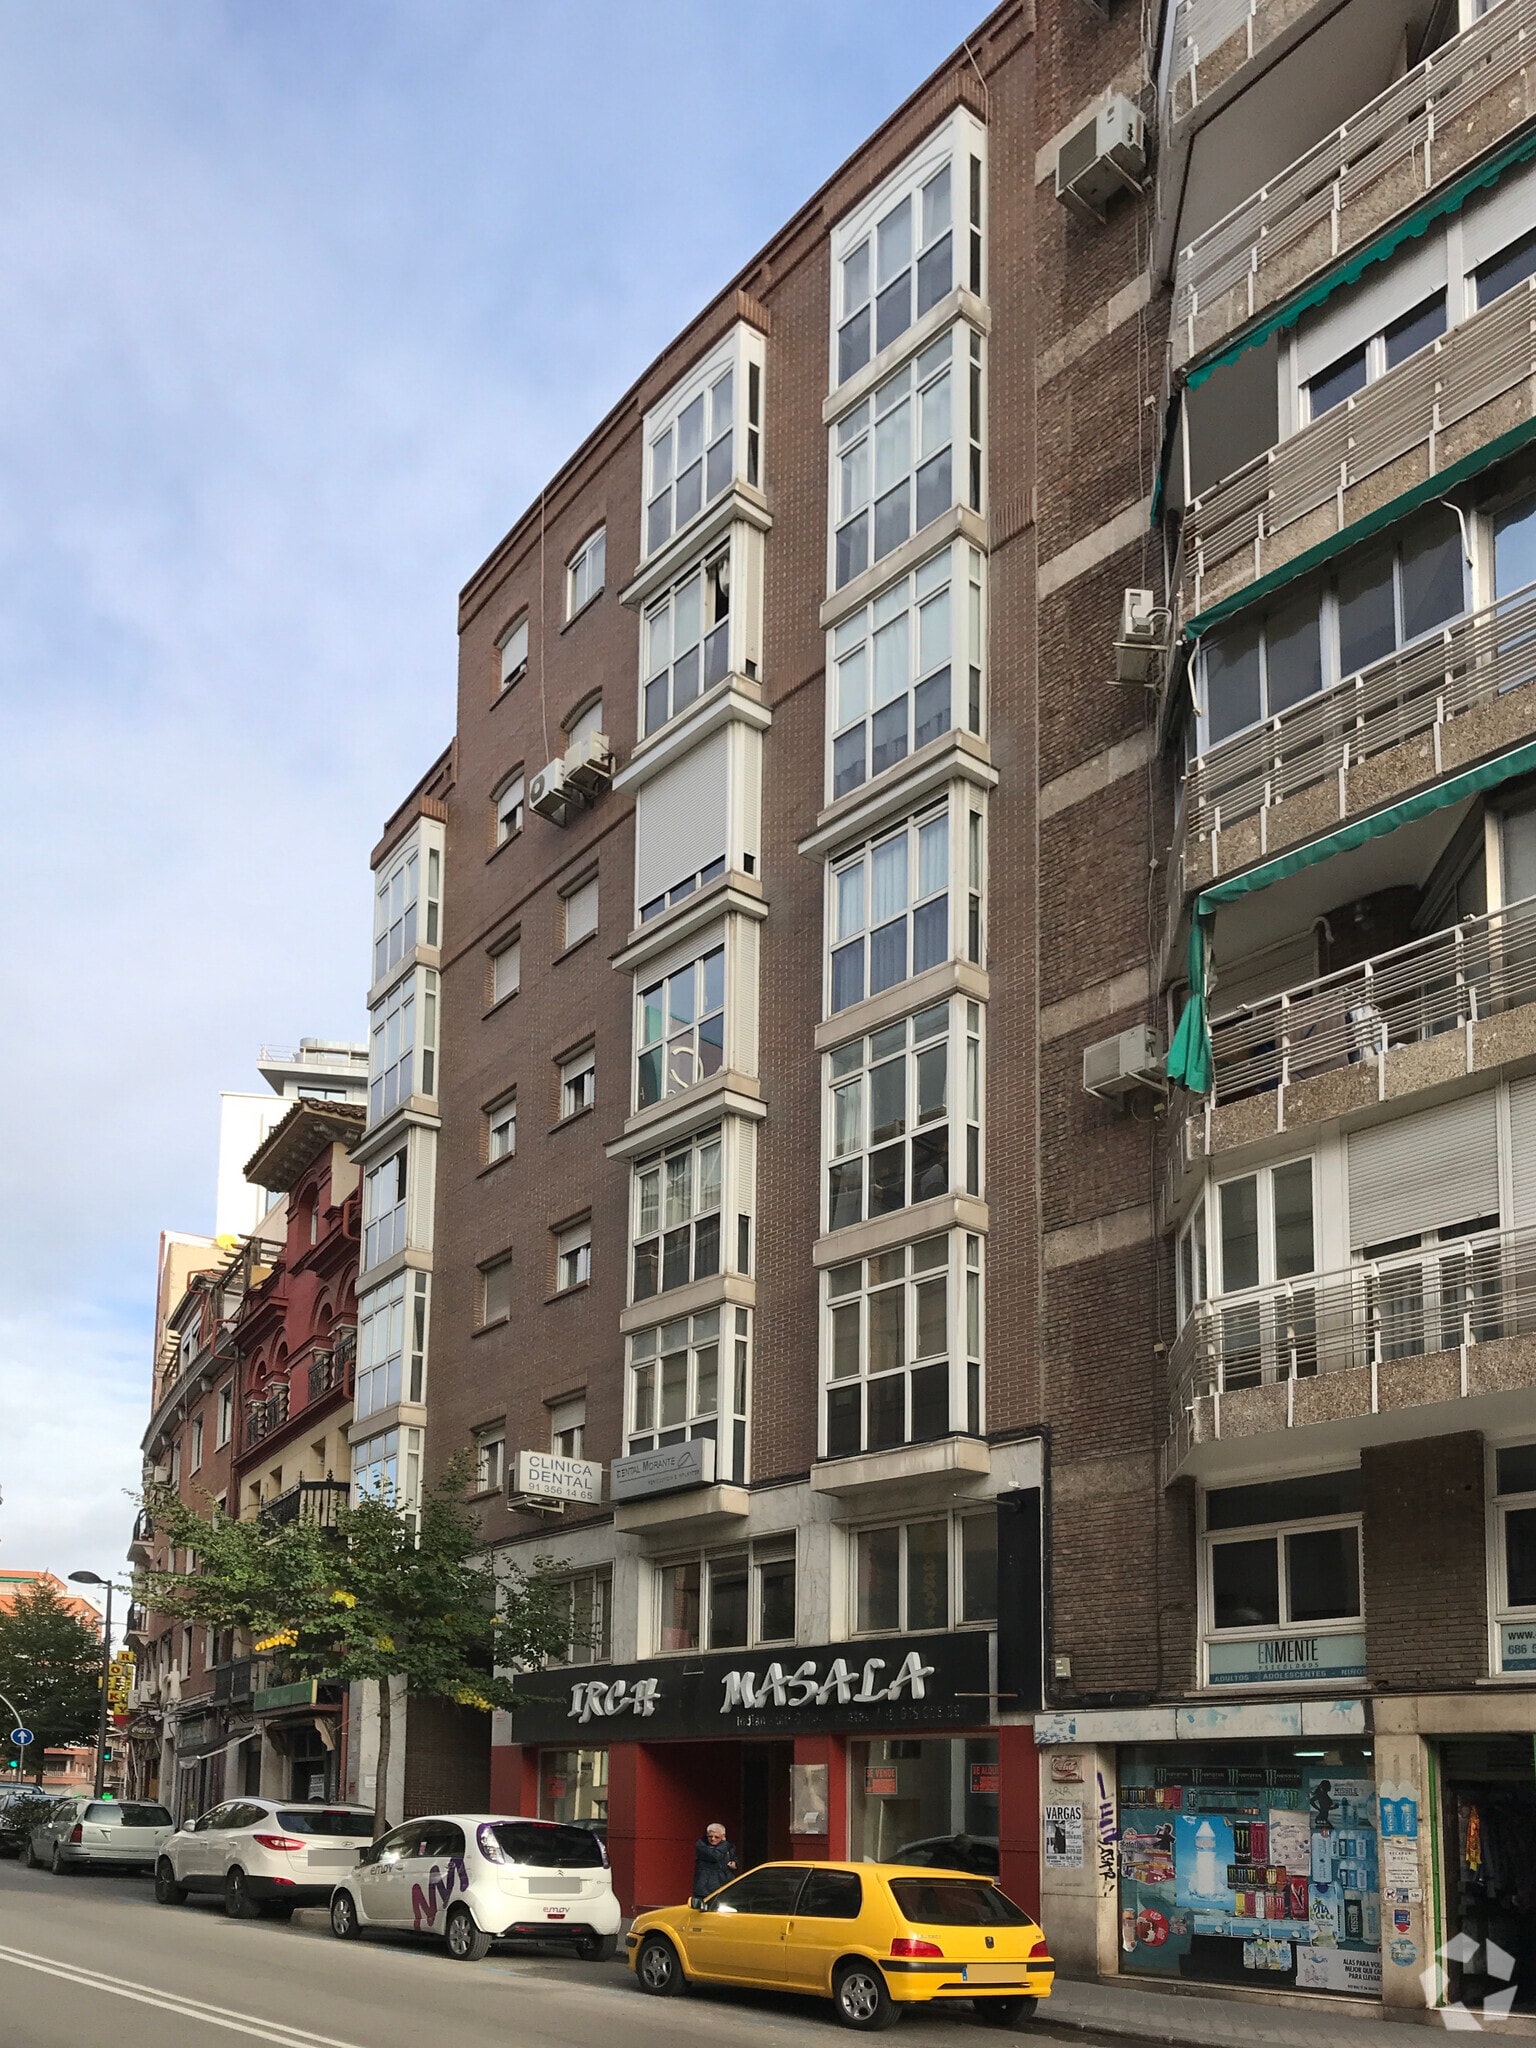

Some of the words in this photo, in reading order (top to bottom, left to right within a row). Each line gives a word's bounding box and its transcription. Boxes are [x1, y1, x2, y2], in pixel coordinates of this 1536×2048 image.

[529, 1456, 593, 1477] CLINICA
[616, 1465, 641, 1479] DENTAL
[642, 1457, 676, 1472] MORANTE
[529, 1469, 593, 1490] DENTAL
[529, 1482, 541, 1492] 91
[544, 1485, 562, 1495] 356
[567, 1488, 578, 1497] 14
[580, 1490, 593, 1500] 65
[1258, 1639, 1319, 1664] ENMENTE
[1508, 1644, 1528, 1655] 686
[719, 1651, 935, 1713] MASALA
[1214, 1674, 1249, 1682] ADULTOS
[1262, 1670, 1327, 1680] ADOLESCENTES
[875, 1768, 896, 1778] VENDE
[1046, 1806, 1082, 1820] VARGAS
[370, 1864, 394, 1876] emov
[543, 1906, 570, 1914] emov
[1345, 1965, 1361, 1973] MEJOR
[1356, 1960, 1370, 1968] PARA
